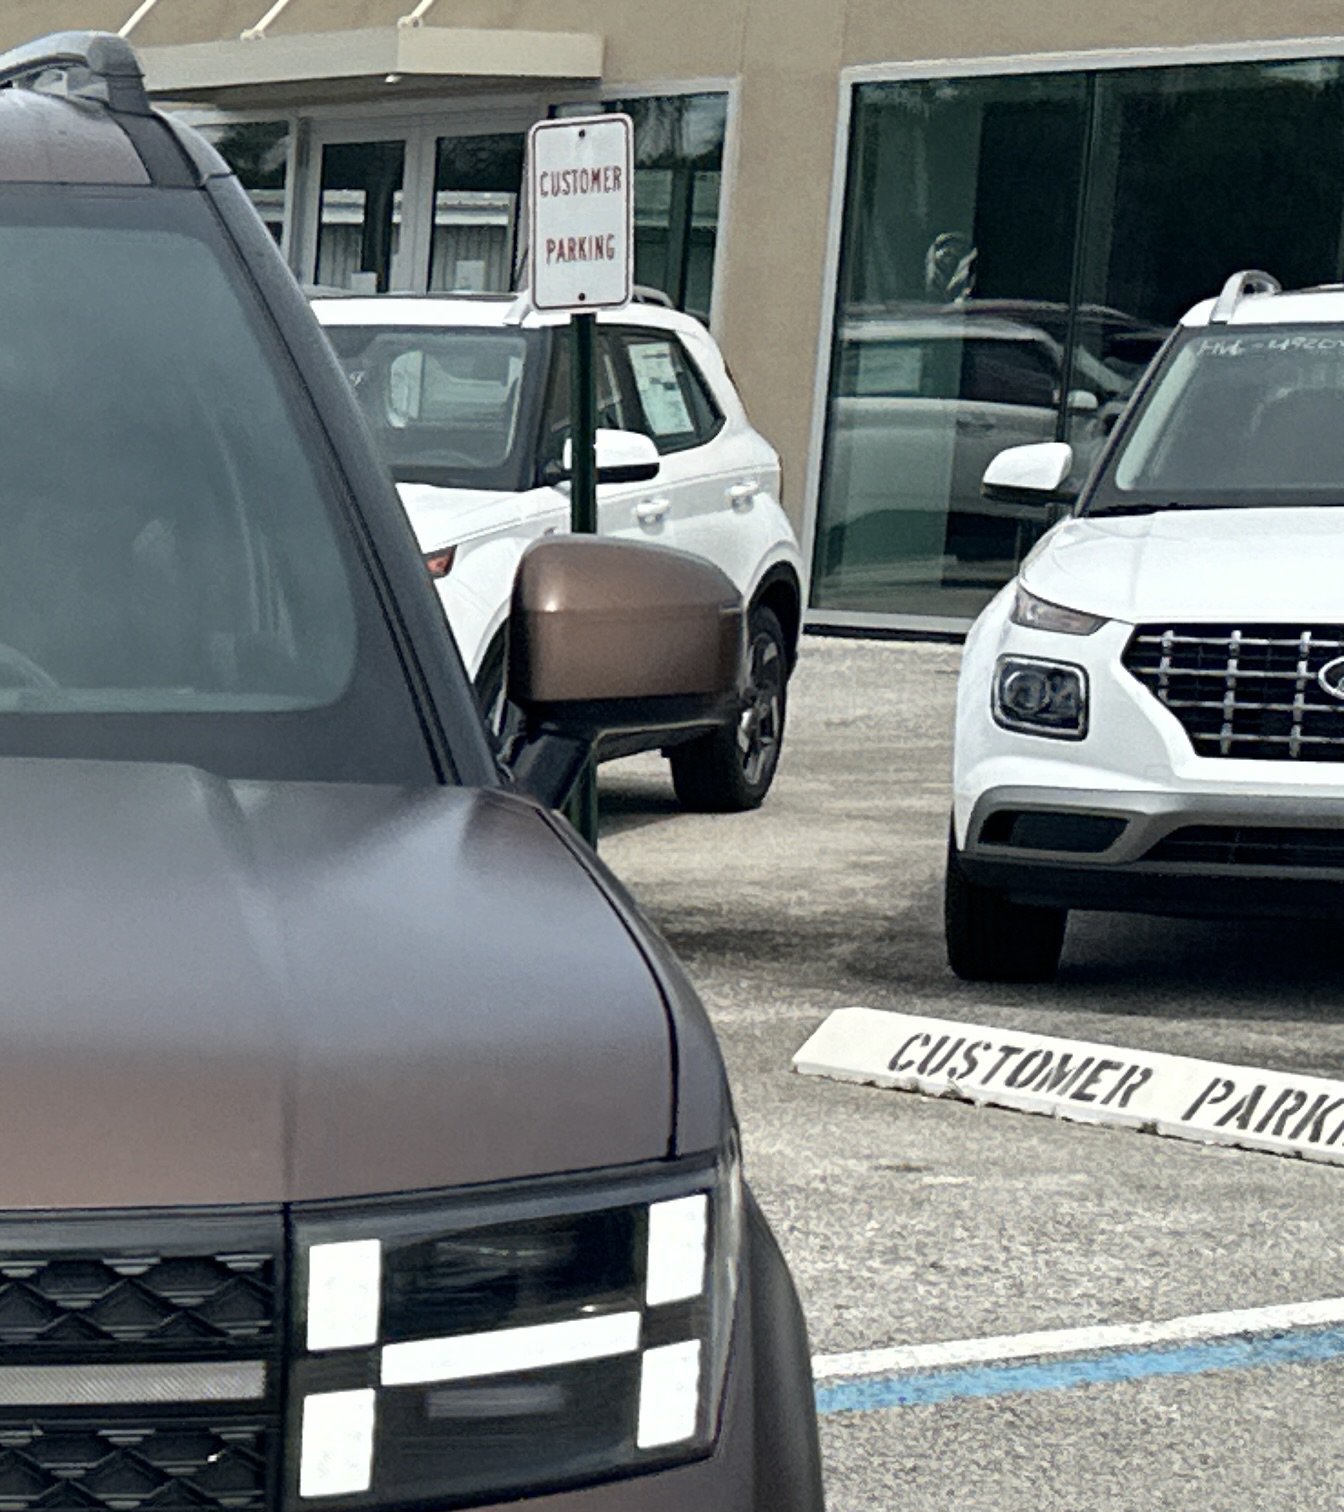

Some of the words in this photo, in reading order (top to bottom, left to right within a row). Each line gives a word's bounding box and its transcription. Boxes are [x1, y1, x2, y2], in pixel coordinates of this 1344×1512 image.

[539, 165, 623, 198] CUSTOMER
[545, 234, 616, 265] PARKING
[887, 1032, 1154, 1109] CUSTOMER
